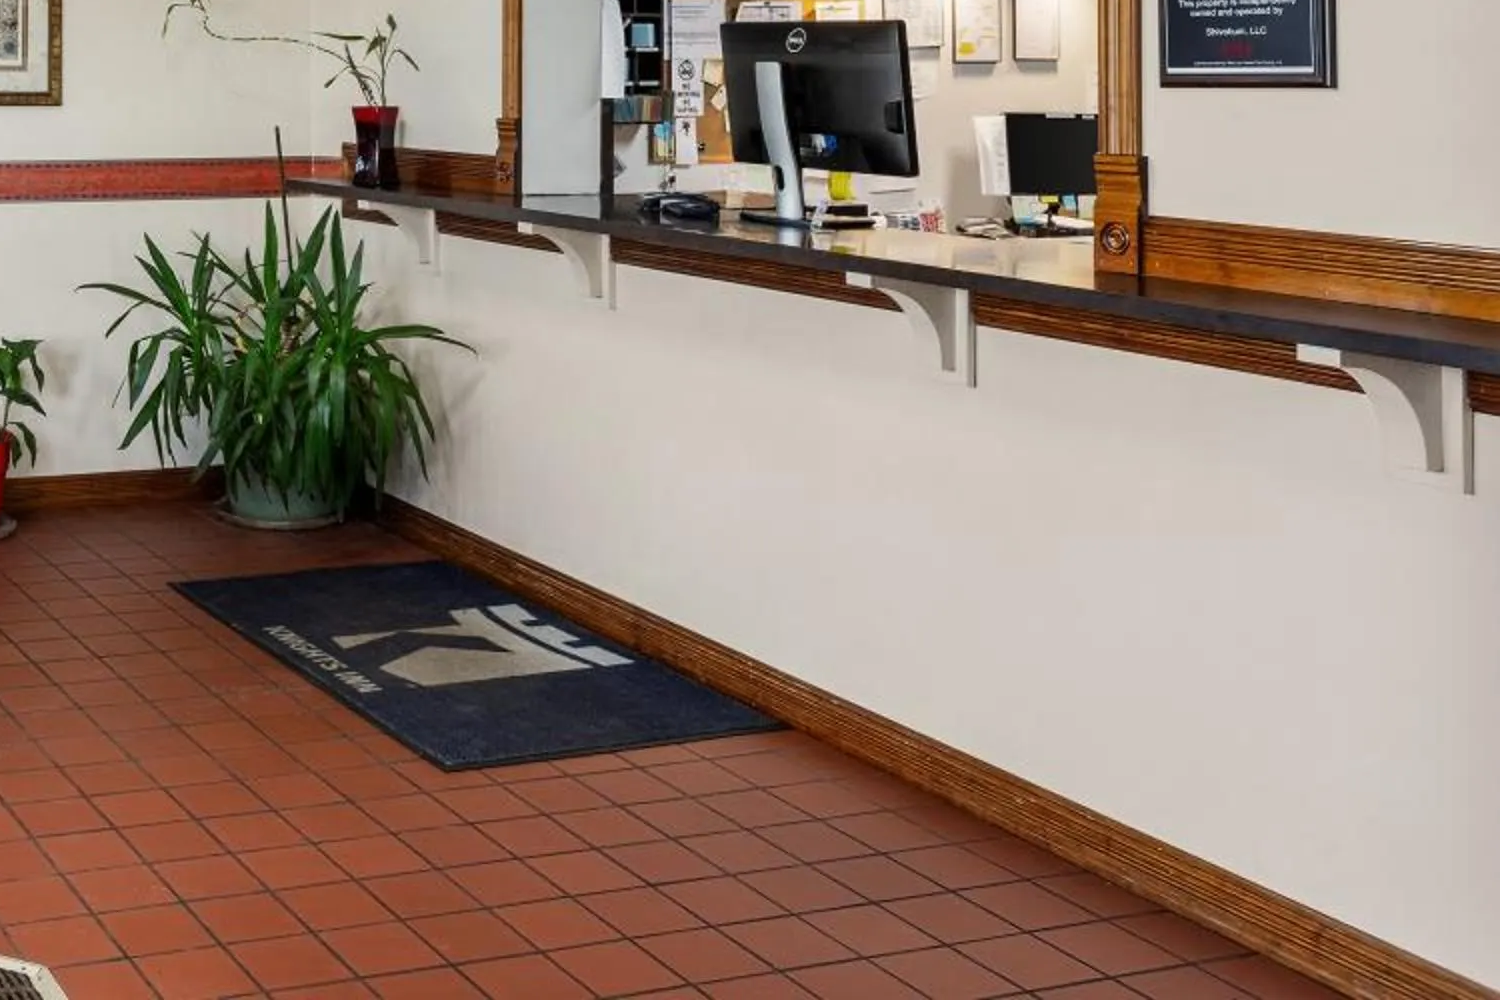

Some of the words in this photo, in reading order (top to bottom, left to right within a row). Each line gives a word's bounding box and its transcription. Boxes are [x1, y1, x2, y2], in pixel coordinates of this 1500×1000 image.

[1189, 7, 1217, 17] owned
[1217, 7, 1233, 17] and
[1234, 5, 1271, 17] operated
[1271, 5, 1284, 17] by
[1249, 25, 1268, 36] LLC
[261, 625, 349, 672] KNIGHTS
[333, 670, 384, 693] INN
